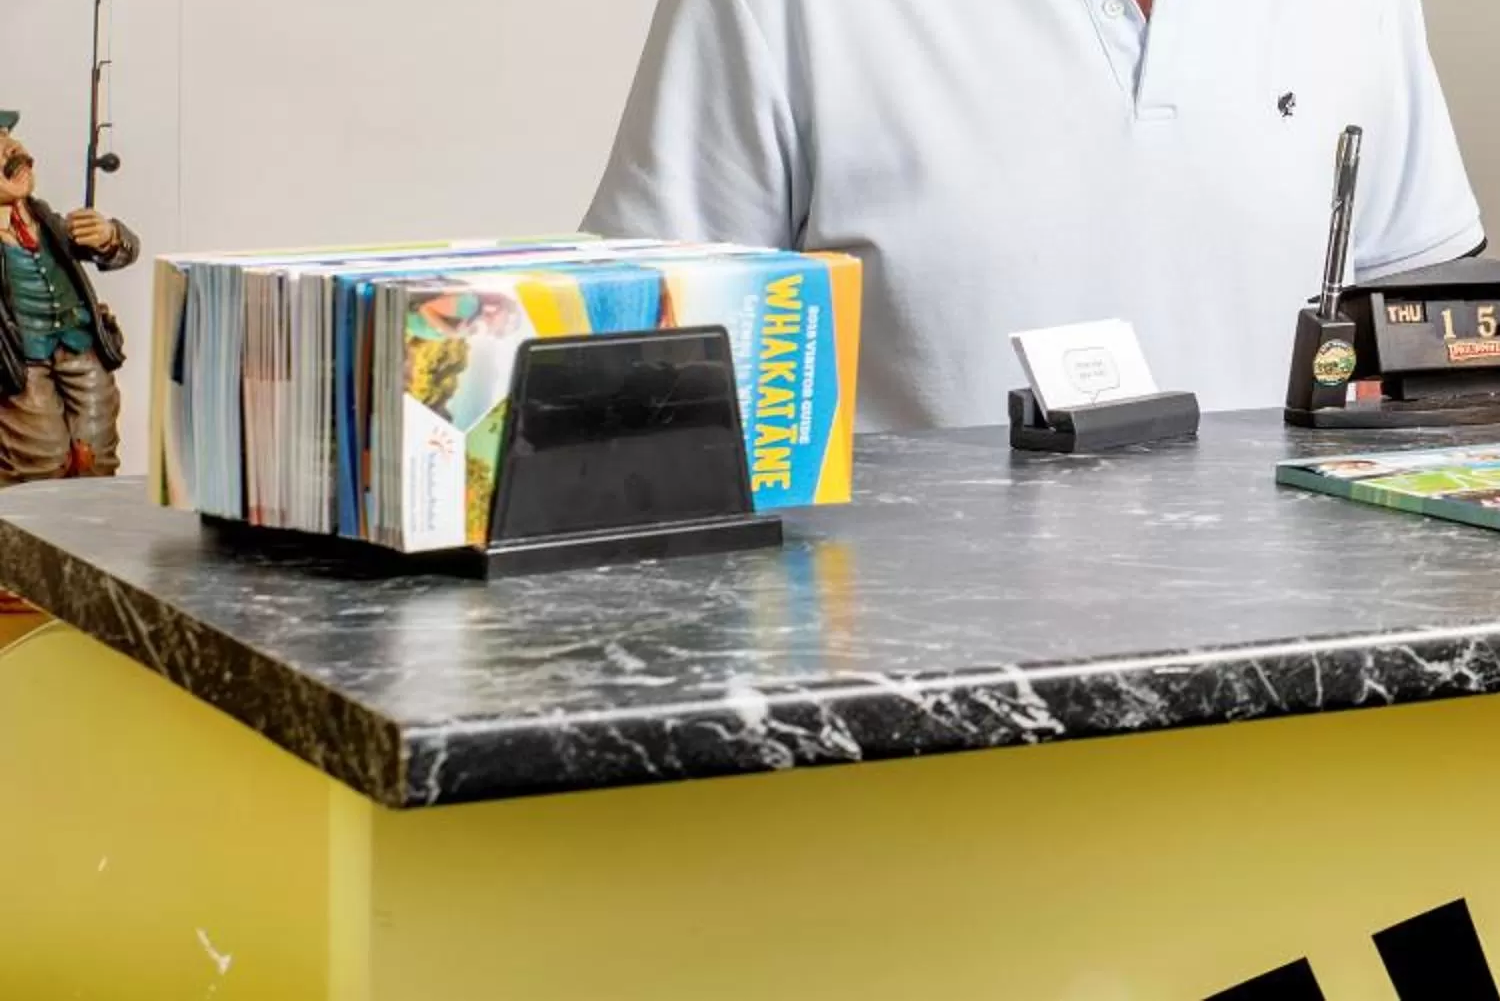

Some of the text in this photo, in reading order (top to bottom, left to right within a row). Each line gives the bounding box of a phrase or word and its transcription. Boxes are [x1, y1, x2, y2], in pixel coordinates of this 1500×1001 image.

[1387, 304, 1421, 322] THU
[752, 274, 804, 492] WHAKATĀNE
[803, 341, 817, 398] VISITOR
[800, 402, 812, 445] GUIDE
